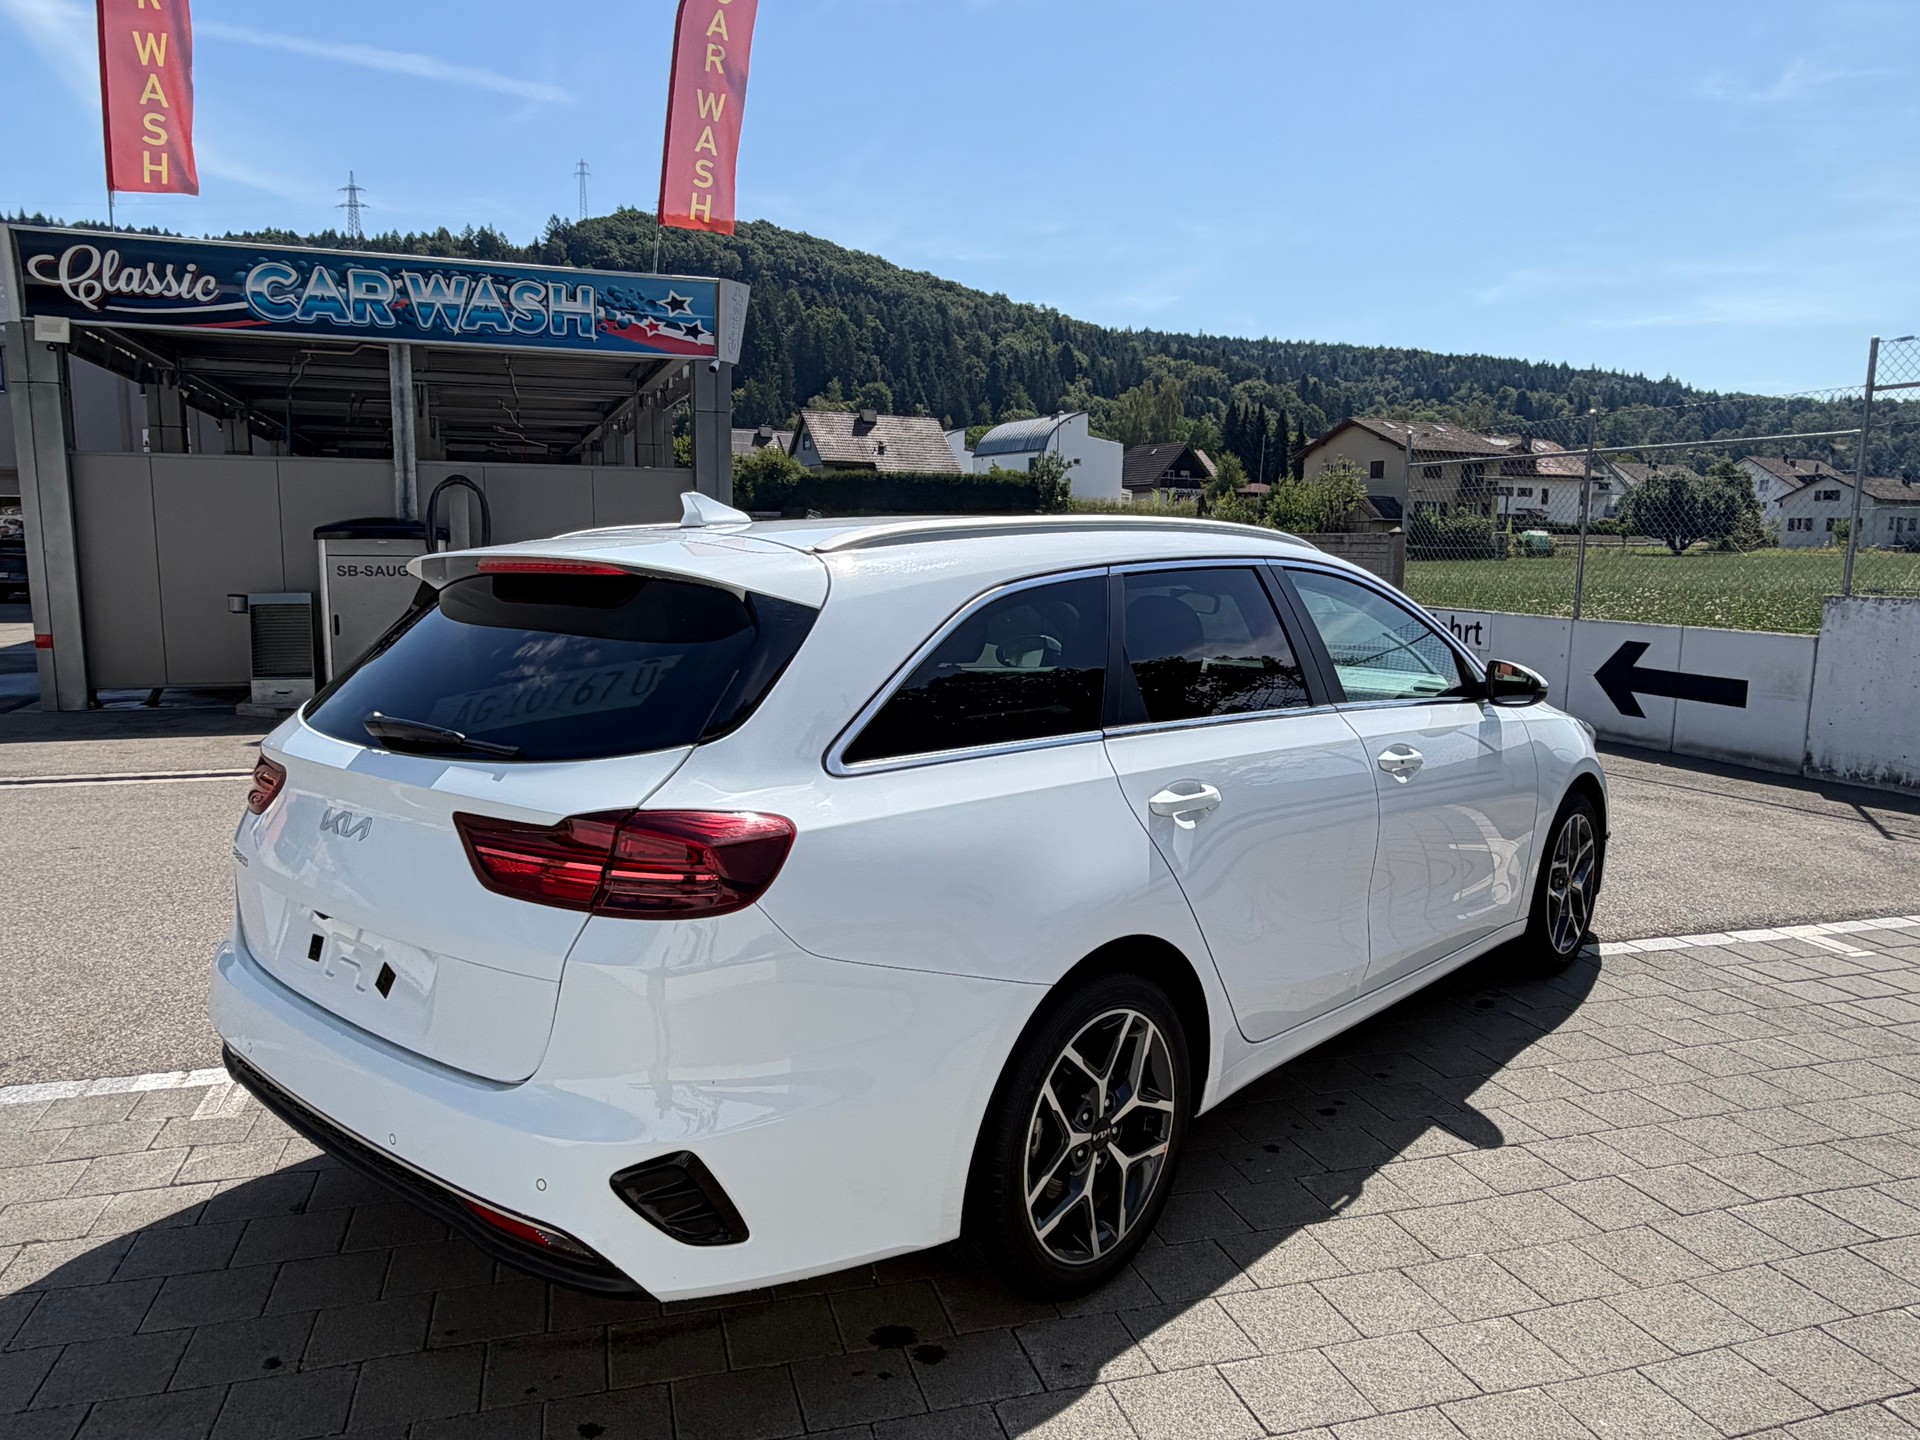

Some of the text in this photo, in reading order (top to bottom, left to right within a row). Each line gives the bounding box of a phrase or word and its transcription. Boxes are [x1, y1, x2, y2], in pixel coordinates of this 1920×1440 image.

[132, 31, 169, 185] WASH
[689, 0, 728, 223] AR WASH
[27, 244, 219, 310] Classic
[245, 262, 397, 329] CAR
[401, 269, 600, 342] WASH
[336, 565, 415, 577] SB-SAUG
[319, 806, 372, 842] KIA
